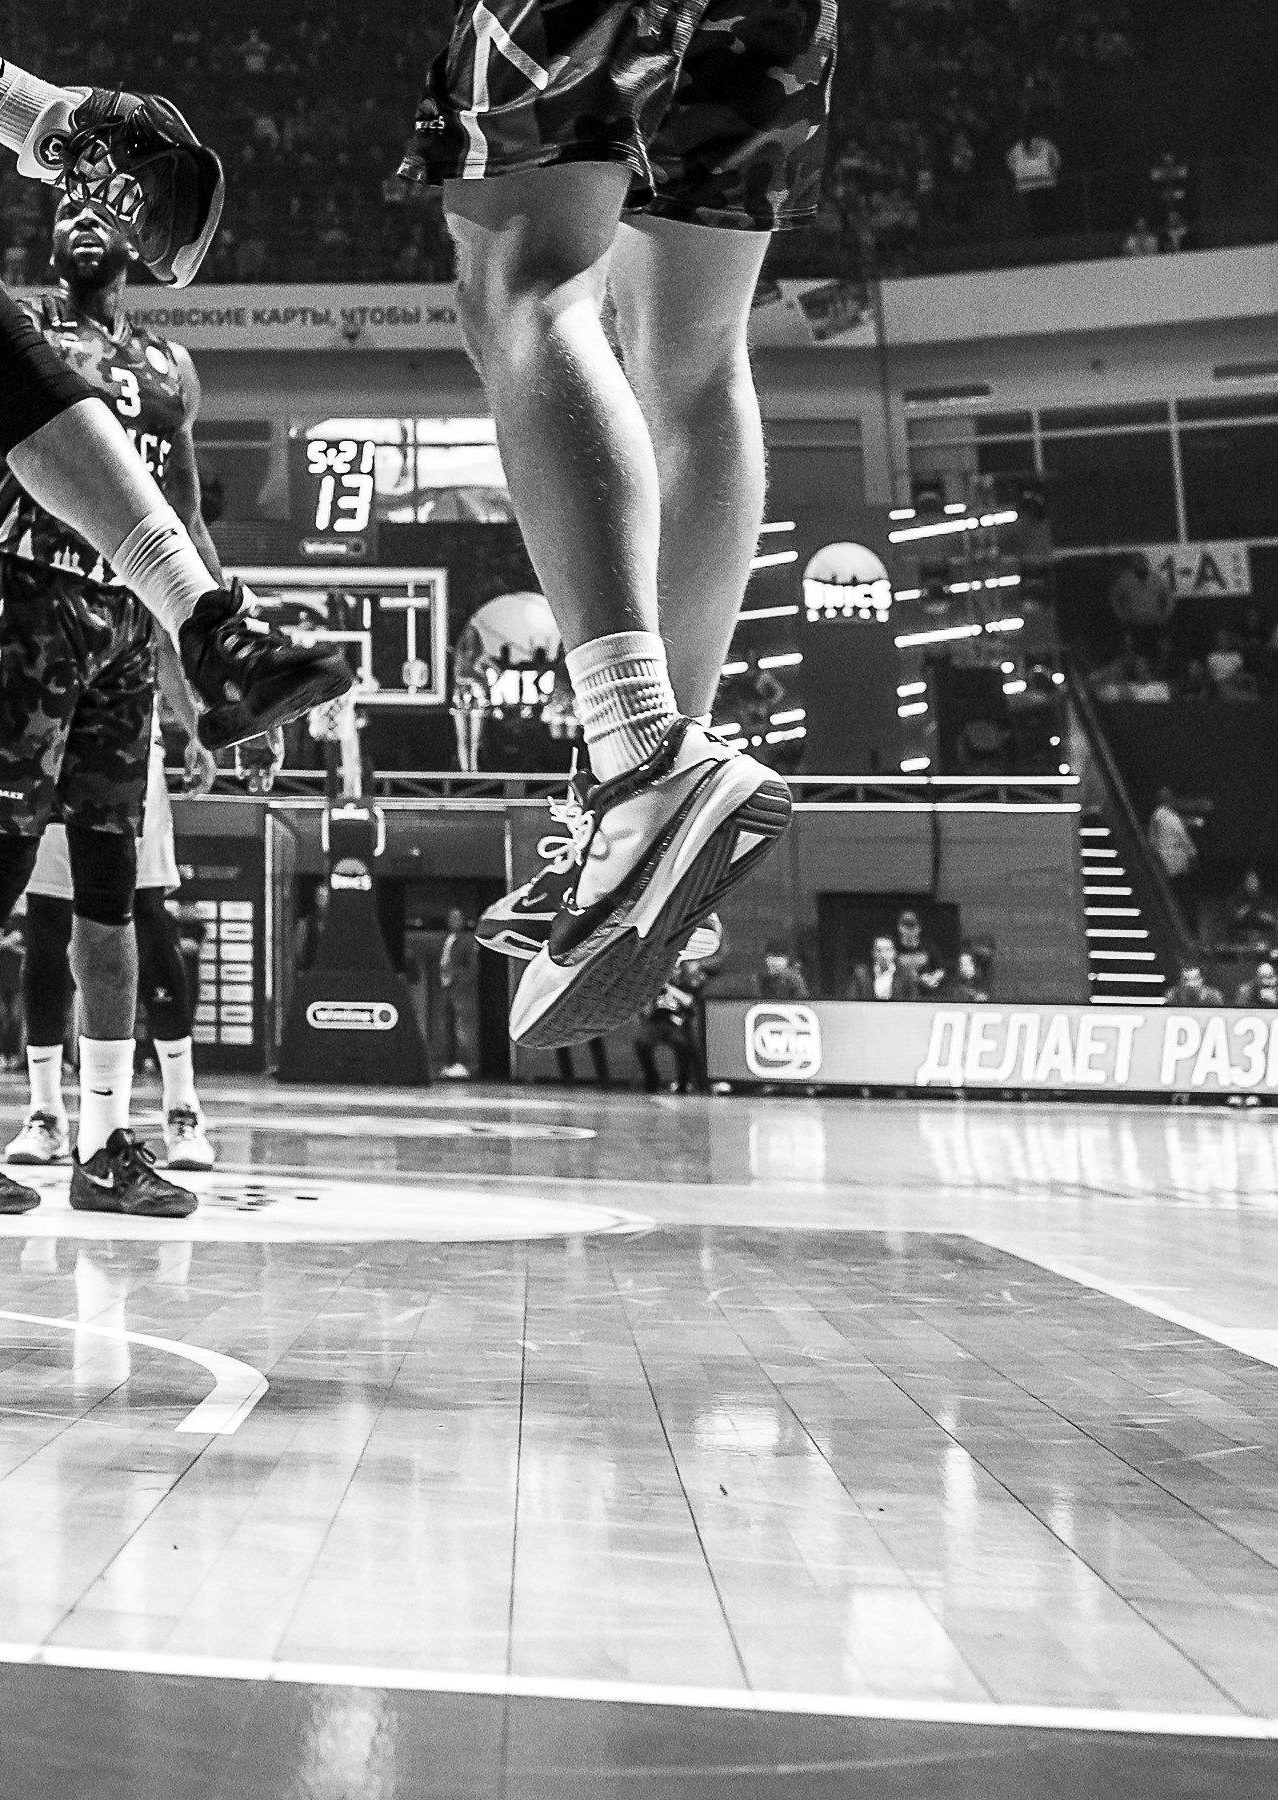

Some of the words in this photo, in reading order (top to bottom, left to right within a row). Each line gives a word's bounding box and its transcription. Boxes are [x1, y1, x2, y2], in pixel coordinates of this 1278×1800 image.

[340, 306, 421, 327] ЧТОБЫ
[110, 366, 142, 418] 3
[315, 473, 374, 532] 13
[916, 1011, 1146, 1088] ДЕЛАЕТ
[1160, 1015, 1278, 1089] РАЗ
